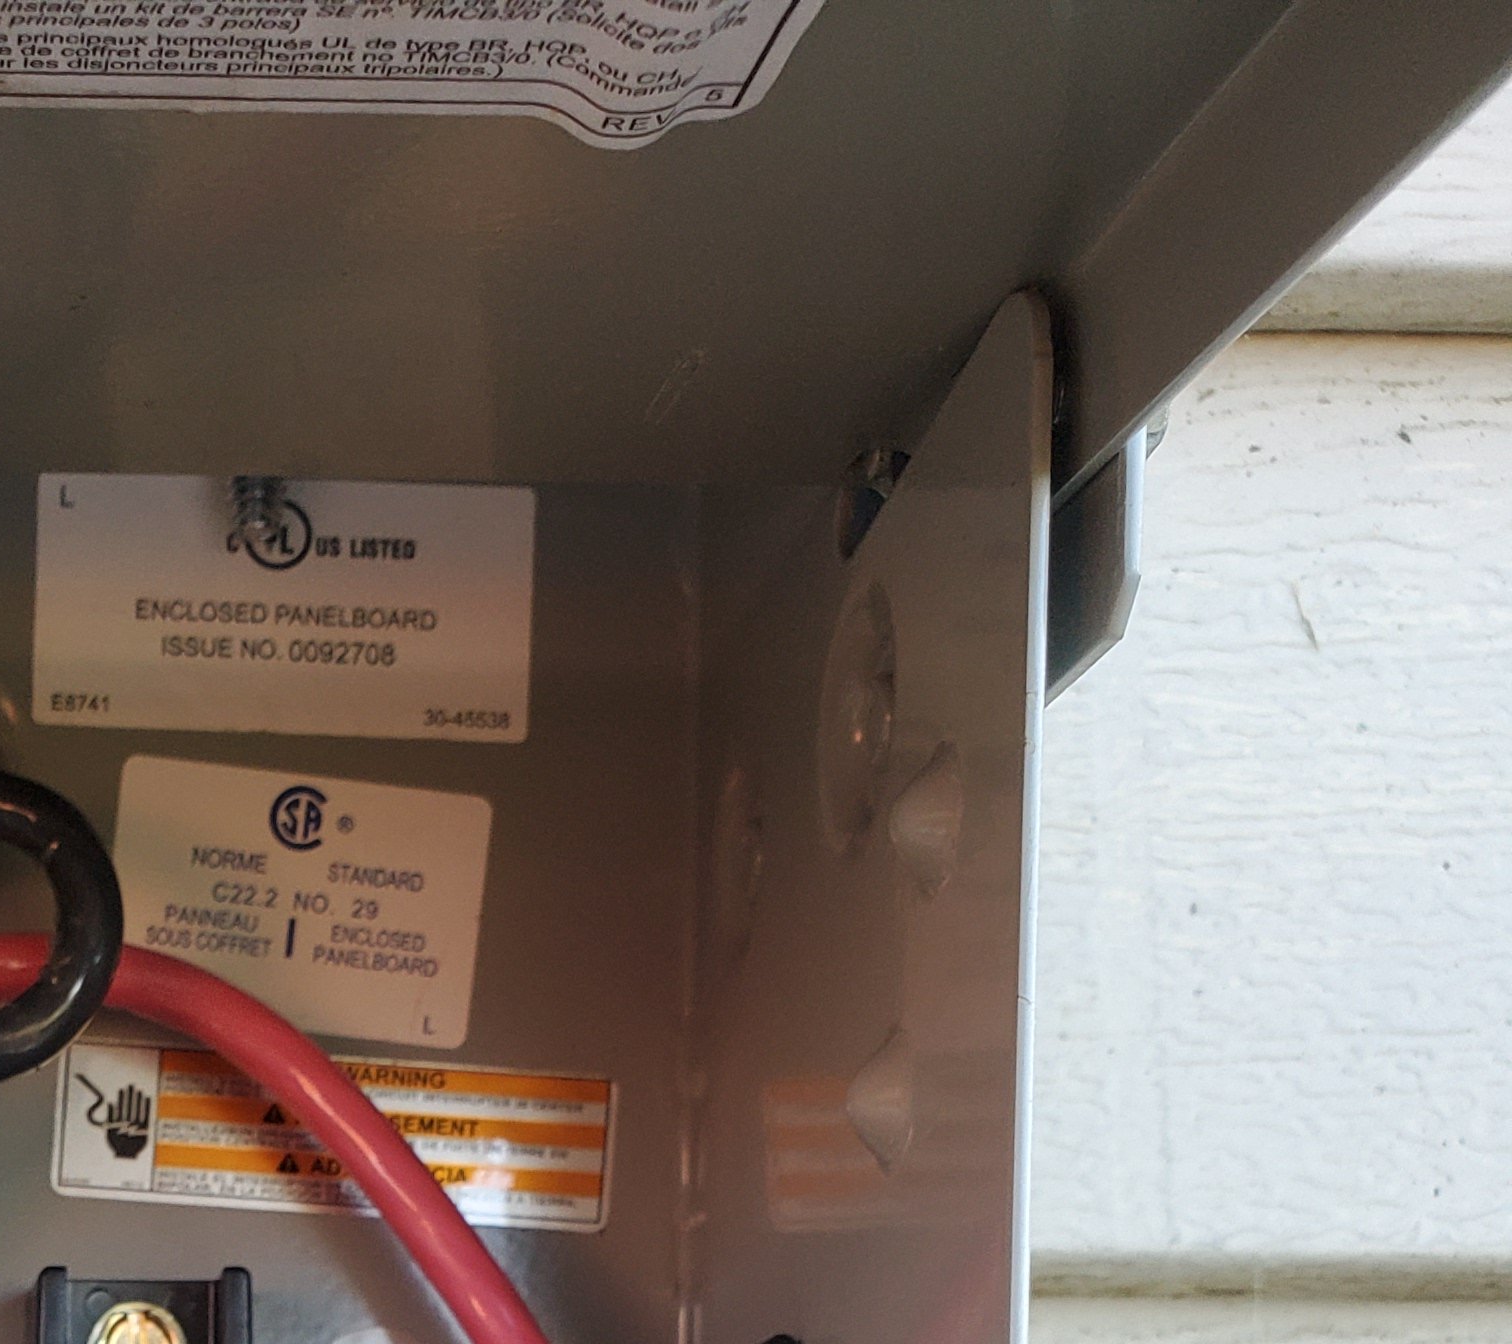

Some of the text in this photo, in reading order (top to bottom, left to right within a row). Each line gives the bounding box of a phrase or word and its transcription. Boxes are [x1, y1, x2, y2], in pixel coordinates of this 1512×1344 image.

[172, 4, 205, 15] de
[157, 16, 189, 28] de
[197, 16, 214, 29] 3
[220, 16, 301, 34] polos)
[17, 32, 148, 47] principaux
[321, 37, 356, 50] UL
[365, 37, 397, 50] de
[405, 39, 460, 53] type
[21, 45, 52, 57] de
[147, 47, 179, 59] de
[23, 58, 59, 69] les
[66, 58, 219, 73] disjoncteurs
[226, 61, 356, 75] principaux
[59, 485, 74, 508] L
[349, 537, 416, 560] LISTED
[134, 598, 438, 632] ENCLOSED PANELBOARD
[160, 635, 232, 659] ISSUE
[240, 637, 283, 661] NO.
[190, 846, 268, 875] NORME
[326, 861, 425, 894] STANDARD
[211, 880, 279, 909] C22.2
[351, 899, 381, 921] 29
[164, 903, 260, 933] PANNEAU
[145, 925, 273, 959] SOUS COFFRET
[330, 924, 427, 953] ENCLOSED
[312, 946, 439, 979] PANELBOARD
